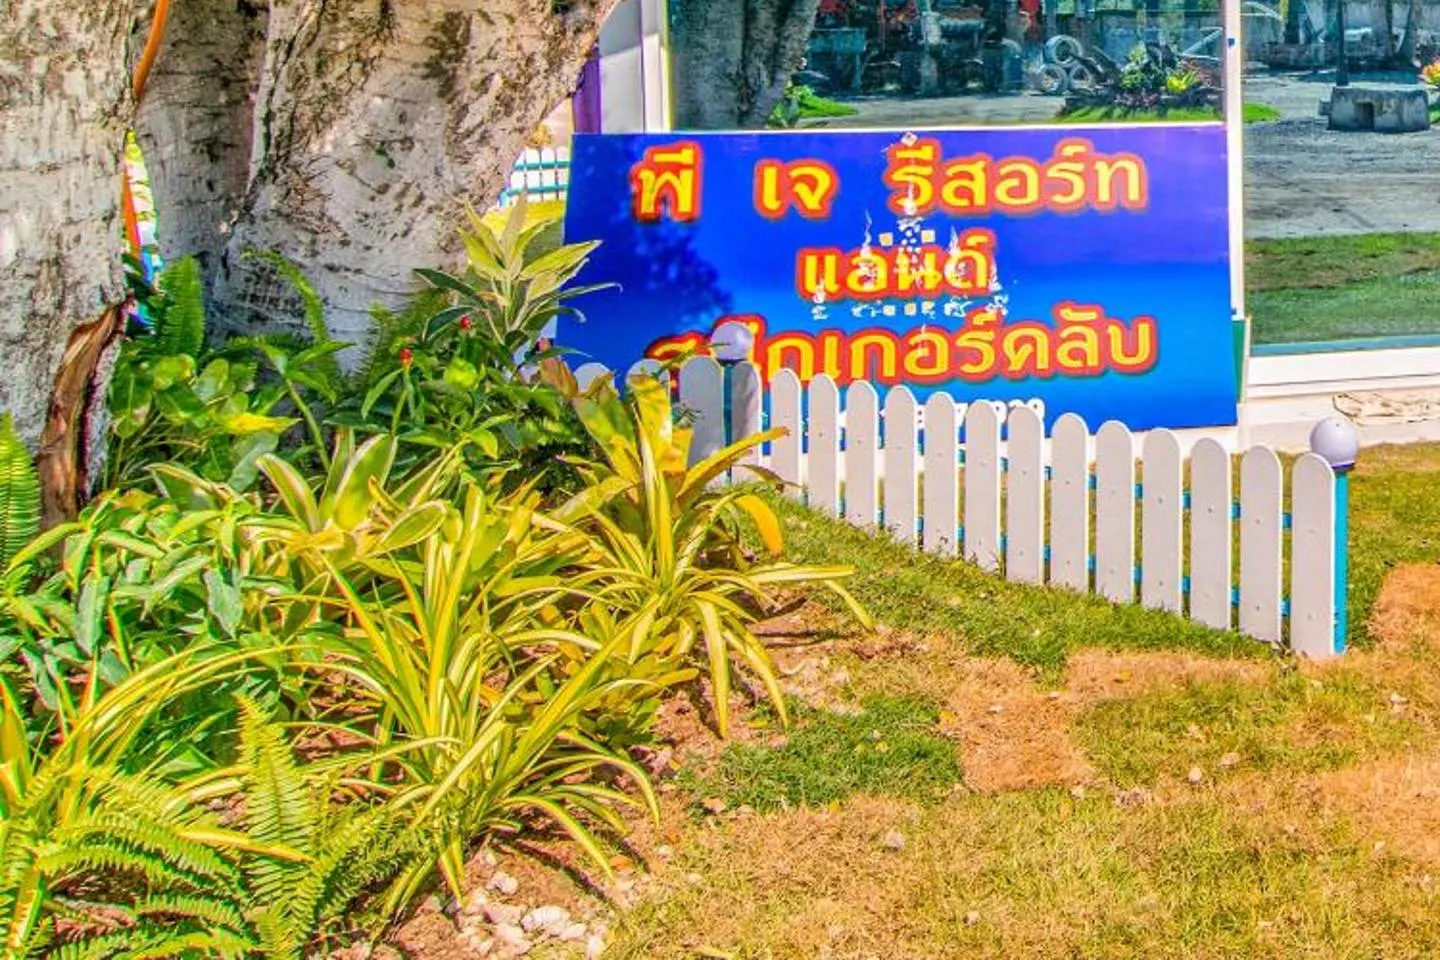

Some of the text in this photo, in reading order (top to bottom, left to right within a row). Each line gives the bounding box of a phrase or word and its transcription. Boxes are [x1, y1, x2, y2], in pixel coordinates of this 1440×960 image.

[633, 138, 1147, 219] พี เจ รีสอร์ท
